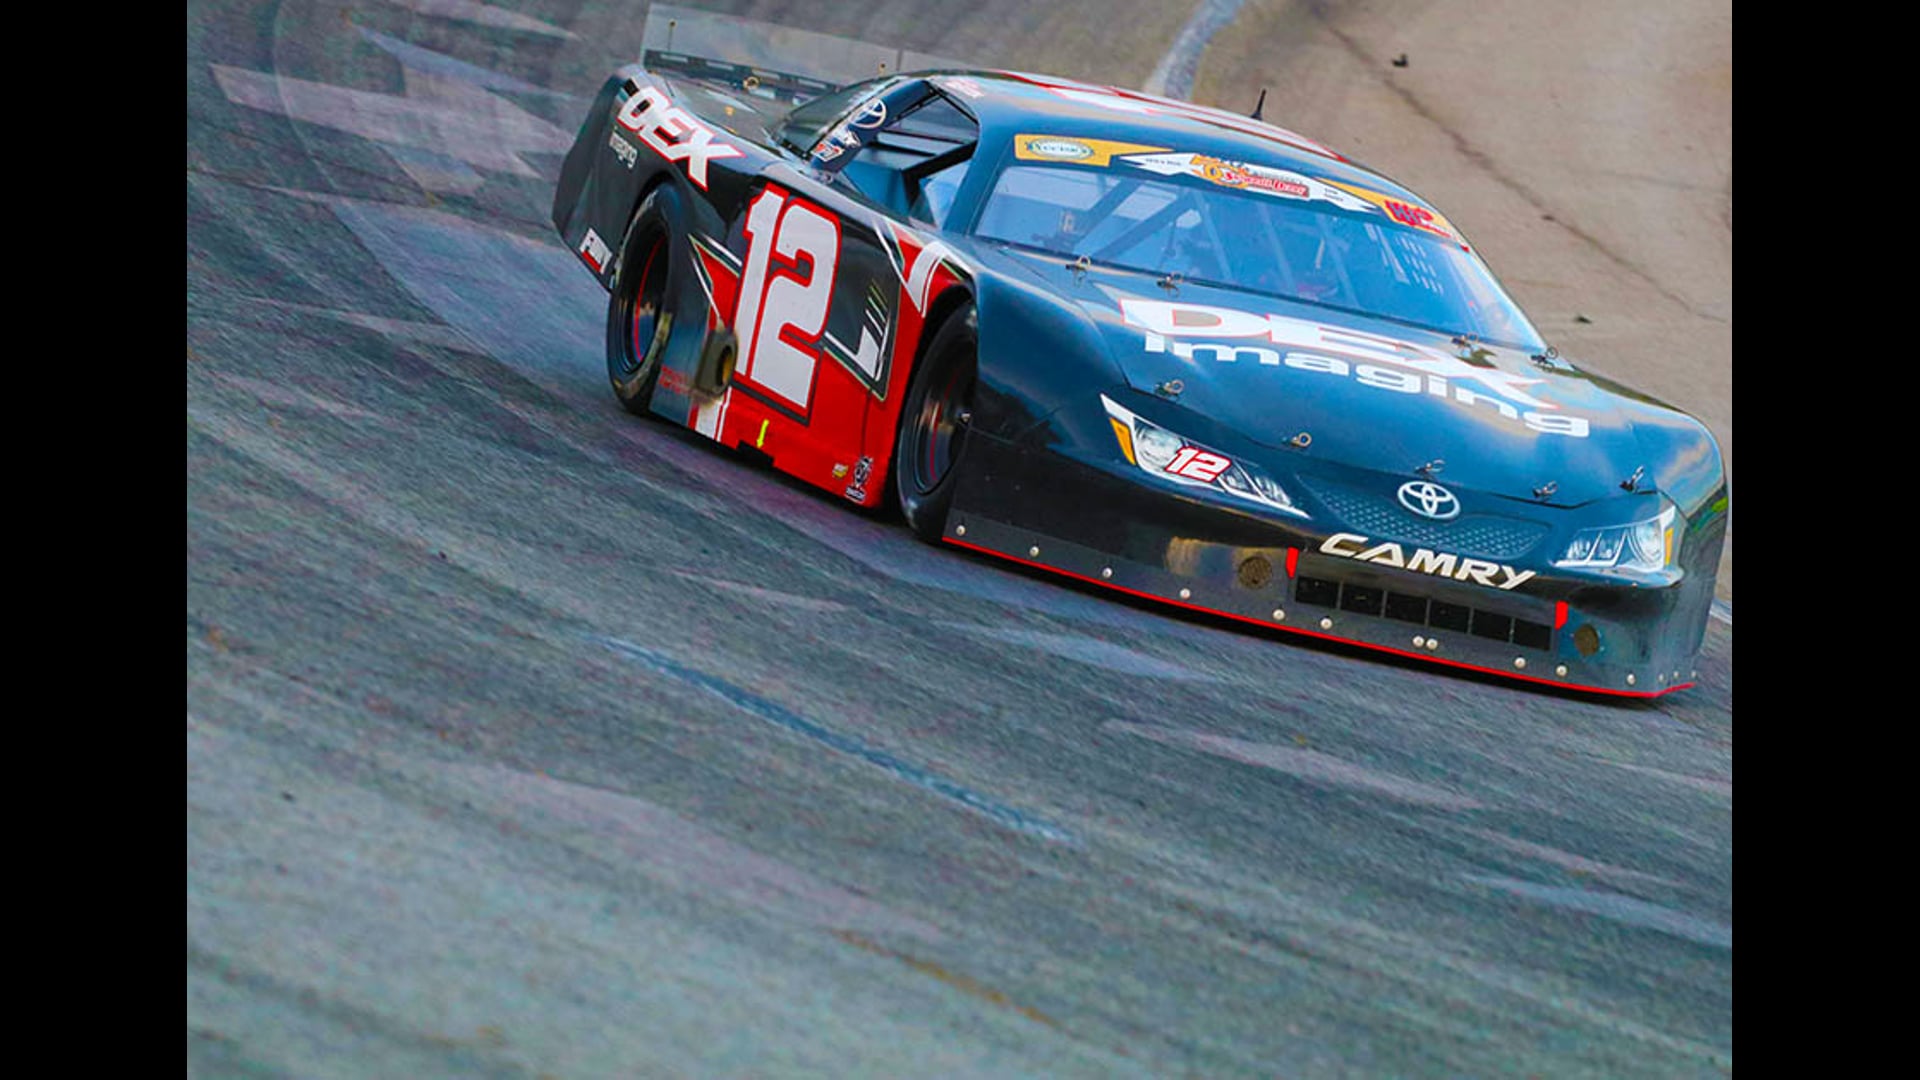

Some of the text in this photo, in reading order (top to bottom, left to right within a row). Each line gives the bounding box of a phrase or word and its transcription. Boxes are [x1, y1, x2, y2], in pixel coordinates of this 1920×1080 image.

[617, 86, 747, 191] DEX
[734, 183, 842, 413] 12
[1119, 298, 1561, 410] DEX
[1166, 446, 1231, 482] 12
[1320, 533, 1536, 590] CAMRY
